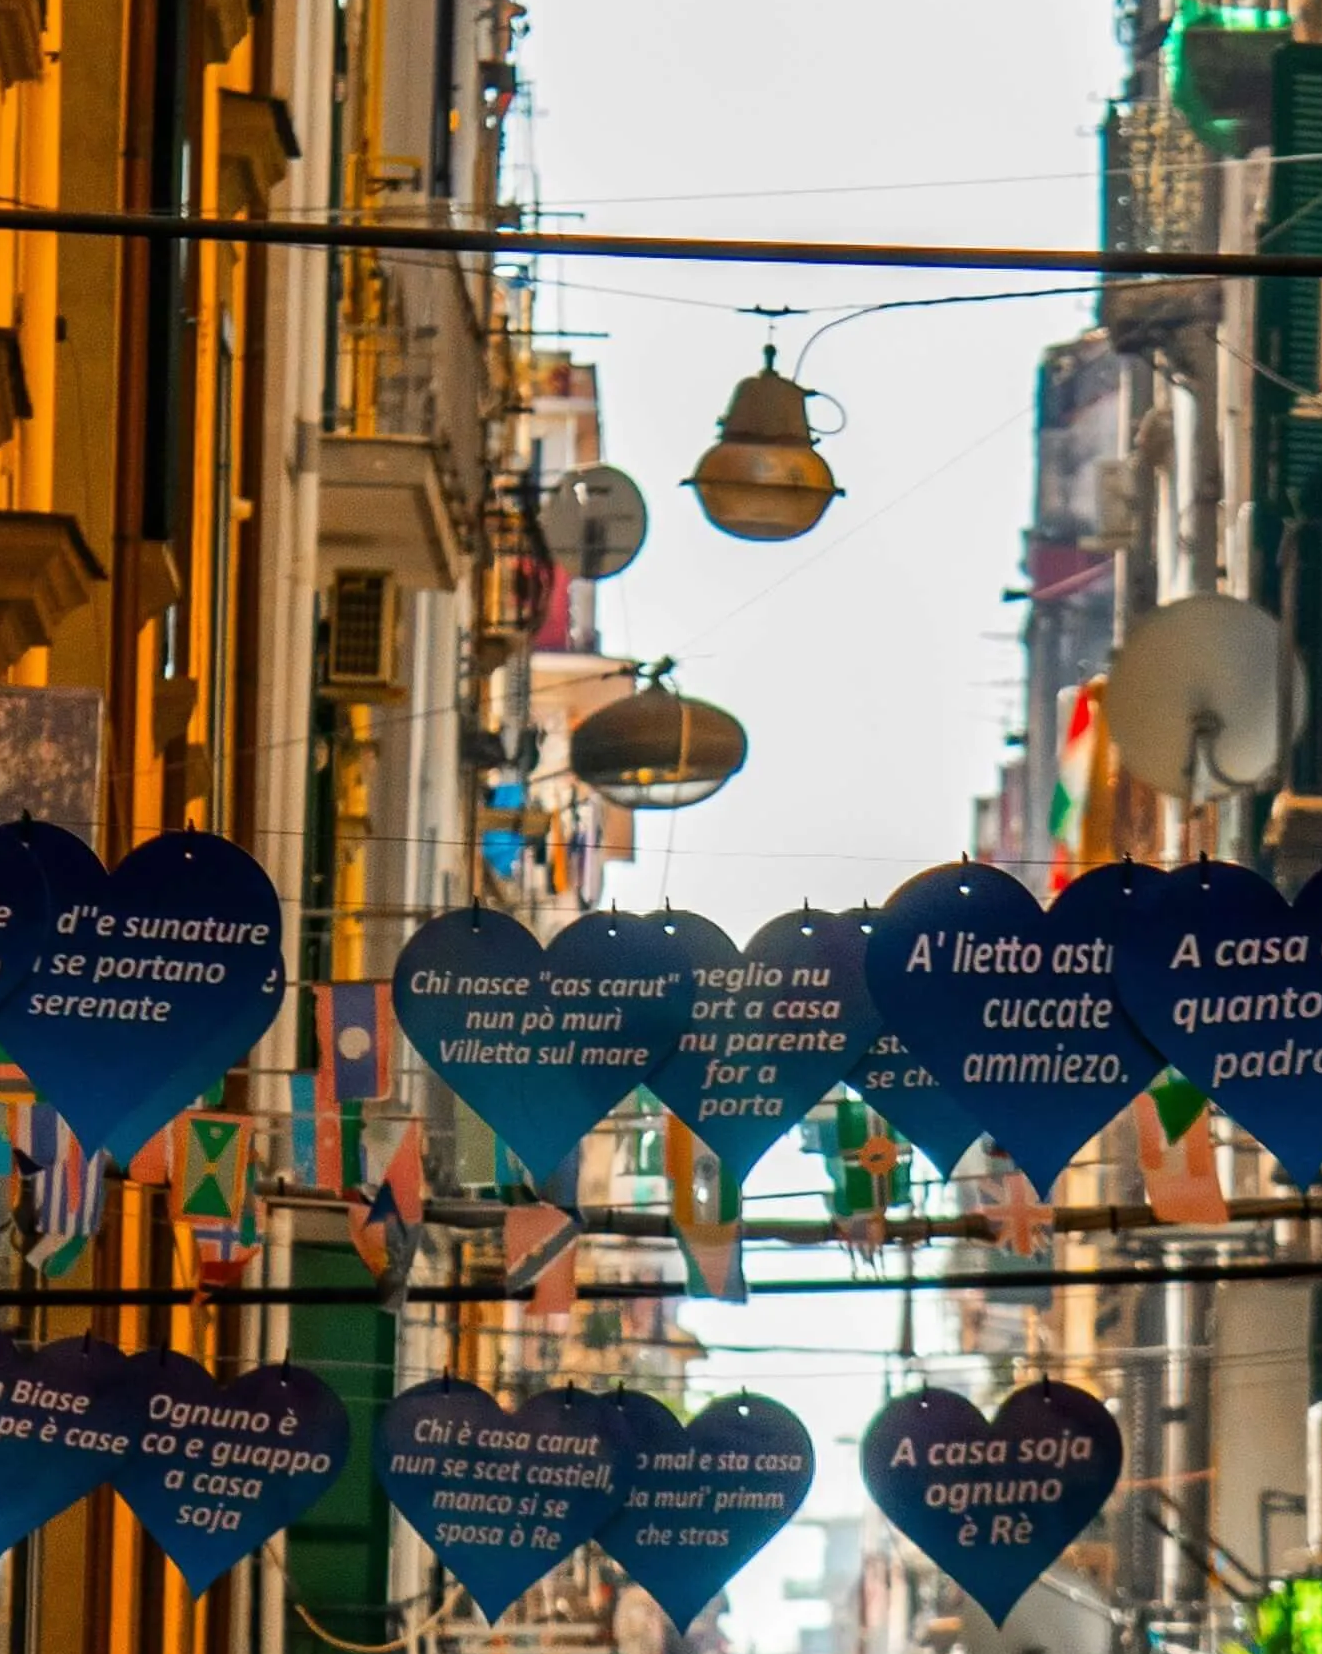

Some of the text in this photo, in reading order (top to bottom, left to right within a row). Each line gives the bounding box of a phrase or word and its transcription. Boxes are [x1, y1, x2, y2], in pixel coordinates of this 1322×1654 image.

[122, 916, 271, 946] sunature
[952, 931, 1043, 974] lietto
[1169, 933, 1202, 970] A
[1214, 935, 1310, 968] casa
[49, 953, 87, 977] se
[92, 954, 226, 985] portano
[410, 969, 452, 995] Chi
[458, 976, 531, 996] nasce
[791, 968, 831, 987] nu
[27, 993, 172, 1023] serenate
[465, 1006, 623, 1036] nun pò murì
[744, 1000, 764, 1020] a
[772, 1000, 841, 1020] casa
[982, 993, 1114, 1029] cuccate
[439, 1038, 649, 1067] Villetta sul mare
[724, 1028, 848, 1057] parente
[700, 1057, 777, 1090] for a
[865, 1070, 896, 1089] se
[962, 1045, 1129, 1084] ammiezo.
[697, 1093, 784, 1123] porta
[10, 1379, 91, 1416] Biase
[148, 1393, 299, 1436] Ognuno è
[38, 1415, 59, 1443] è
[63, 1426, 130, 1456] case
[414, 1417, 600, 1457] Chi è casa carut
[889, 1428, 1093, 1469] A casa soja
[140, 1432, 332, 1477] co e guappo
[652, 1446, 696, 1471] mal
[698, 1453, 713, 1471] e
[717, 1450, 750, 1472] sta
[754, 1454, 803, 1472] casa
[164, 1469, 264, 1500] a casa
[390, 1454, 615, 1494] nun se scet castiell,
[432, 1490, 570, 1519] manco si se
[713, 1485, 785, 1514] primm
[924, 1478, 1063, 1515] ognuno
[175, 1502, 242, 1535] soja
[957, 1512, 1034, 1547] è Rè
[434, 1522, 502, 1546] sposa
[509, 1522, 526, 1547] ò
[635, 1522, 730, 1547] che stras
